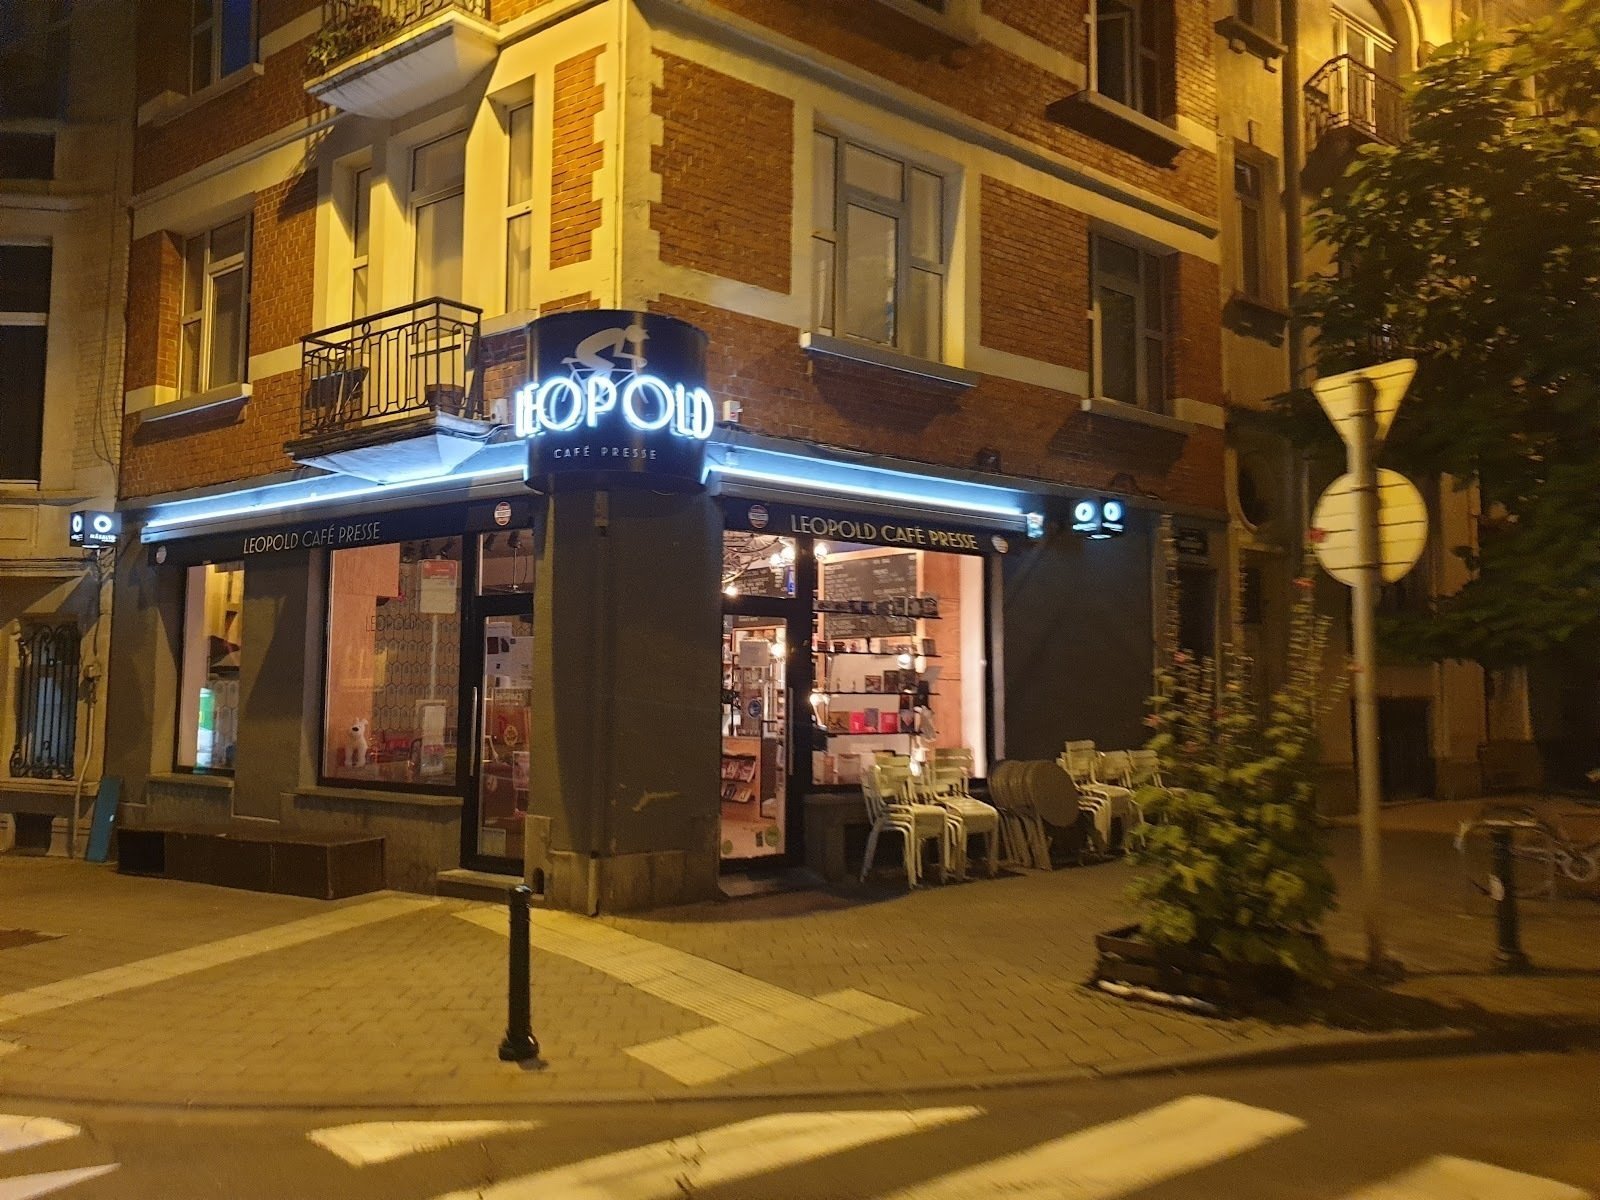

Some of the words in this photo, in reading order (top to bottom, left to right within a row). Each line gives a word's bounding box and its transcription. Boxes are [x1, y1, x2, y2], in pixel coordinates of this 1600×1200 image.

[515, 375, 714, 439] LEOPOLD
[554, 445, 590, 459] CAFÉ
[601, 447, 657, 460] PRESSE
[244, 533, 298, 554] LEOPOLD
[302, 524, 334, 548] CAFÉ
[338, 521, 381, 544] PRESSE
[791, 514, 876, 540] LEOPOLD
[881, 524, 925, 545] CAFÉ
[928, 530, 979, 550] PRESSE
